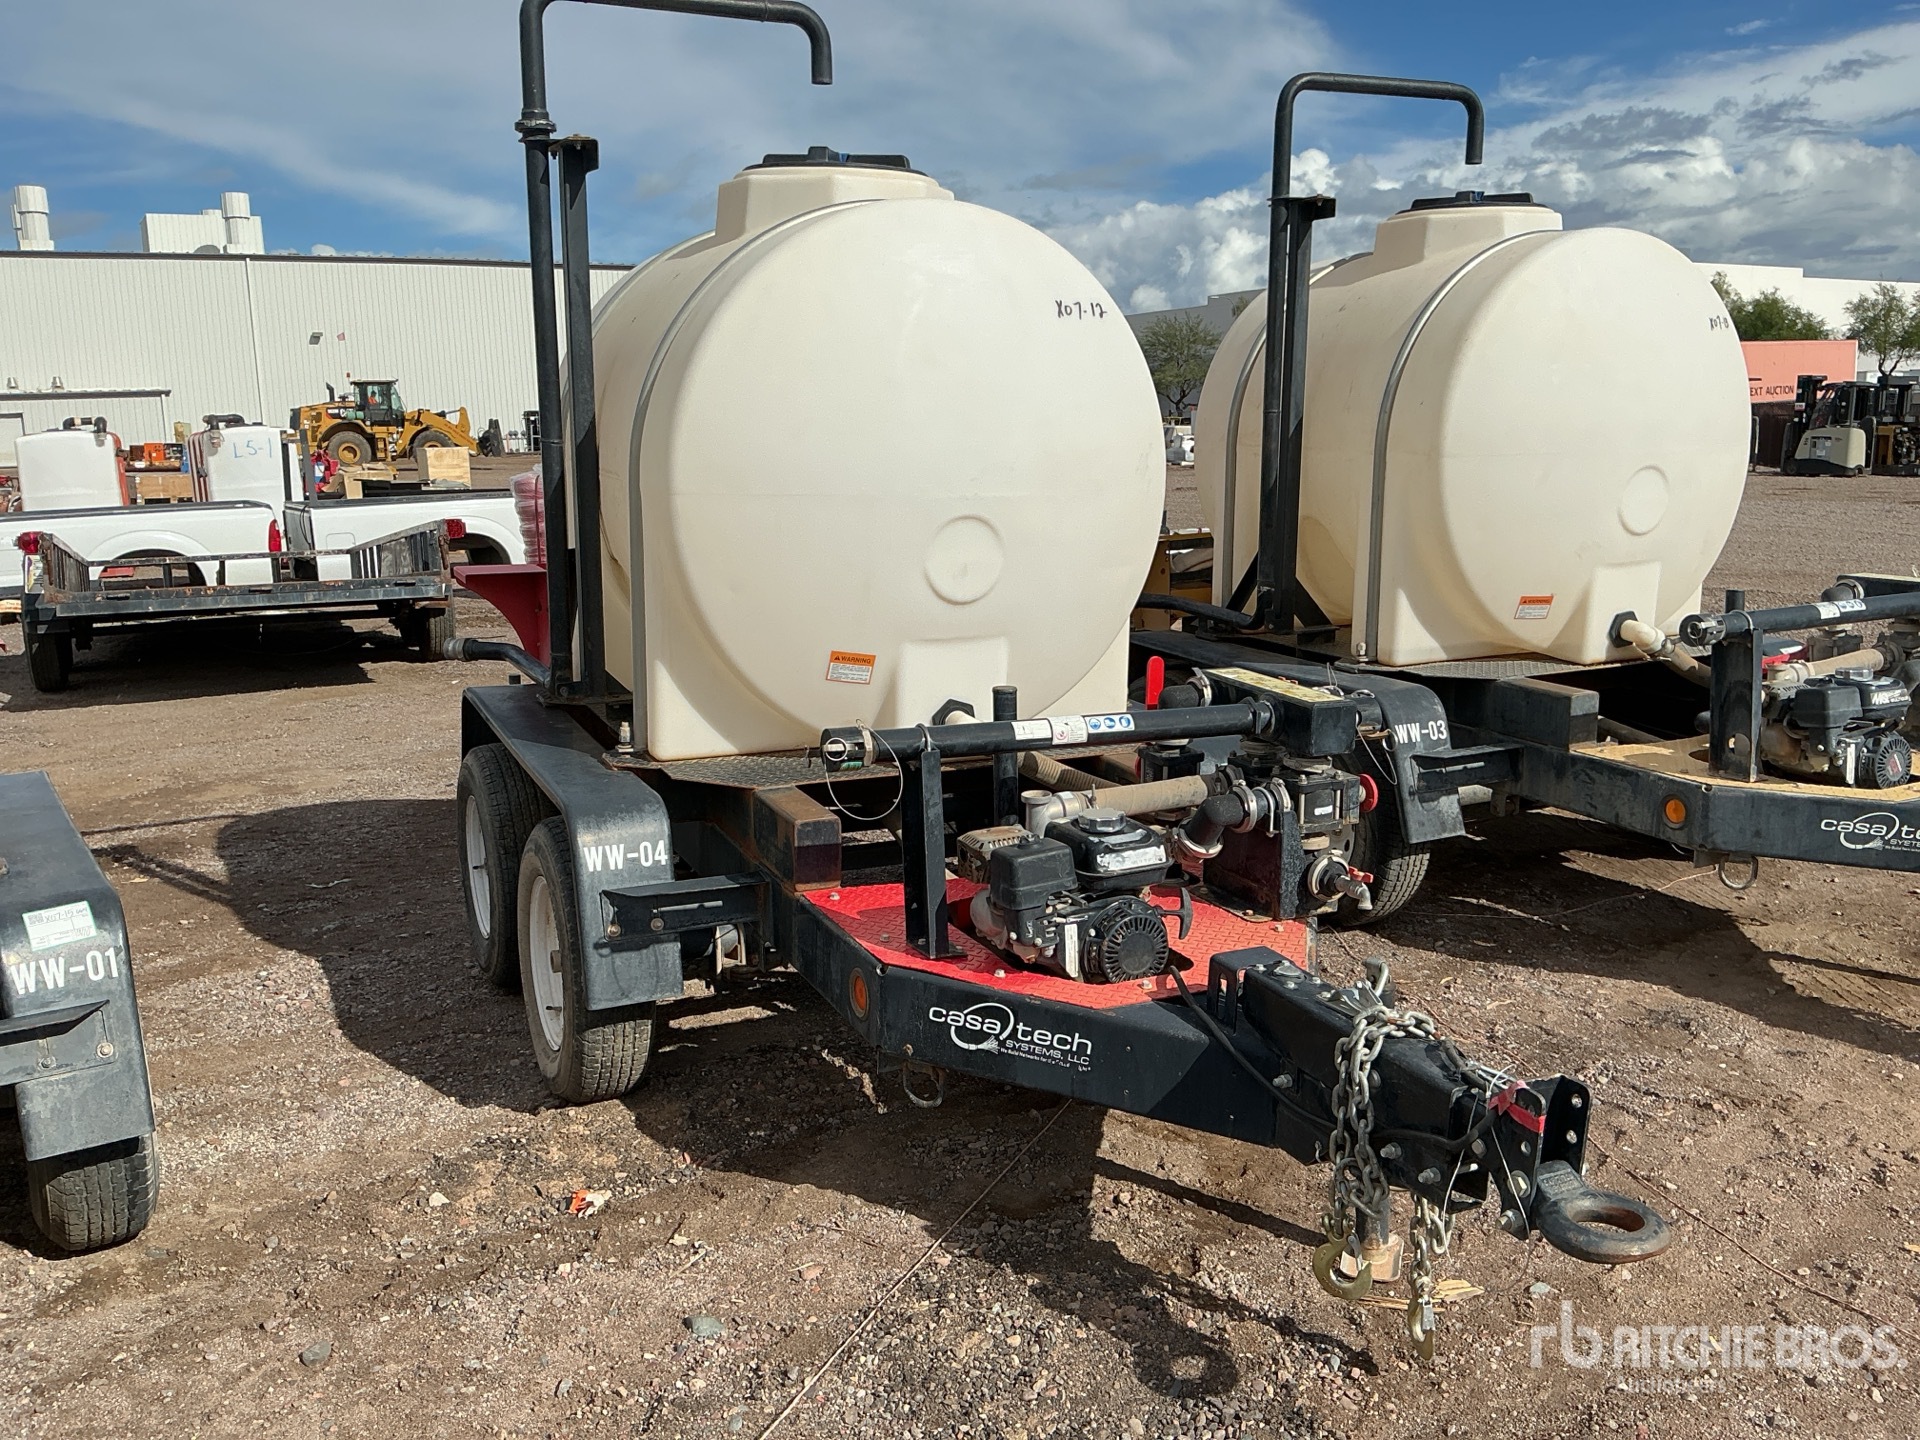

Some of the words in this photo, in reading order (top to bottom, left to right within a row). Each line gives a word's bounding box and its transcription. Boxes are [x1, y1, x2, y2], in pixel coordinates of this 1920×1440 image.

[1766, 385, 1794, 395] AUCTION
[841, 655, 871, 665] WARNING
[1394, 719, 1448, 744] WW-03
[583, 839, 668, 873] WW-04
[10, 947, 119, 996] WW-01
[1016, 1022, 1093, 1055] tech
[1067, 1053, 1091, 1065] LLC
